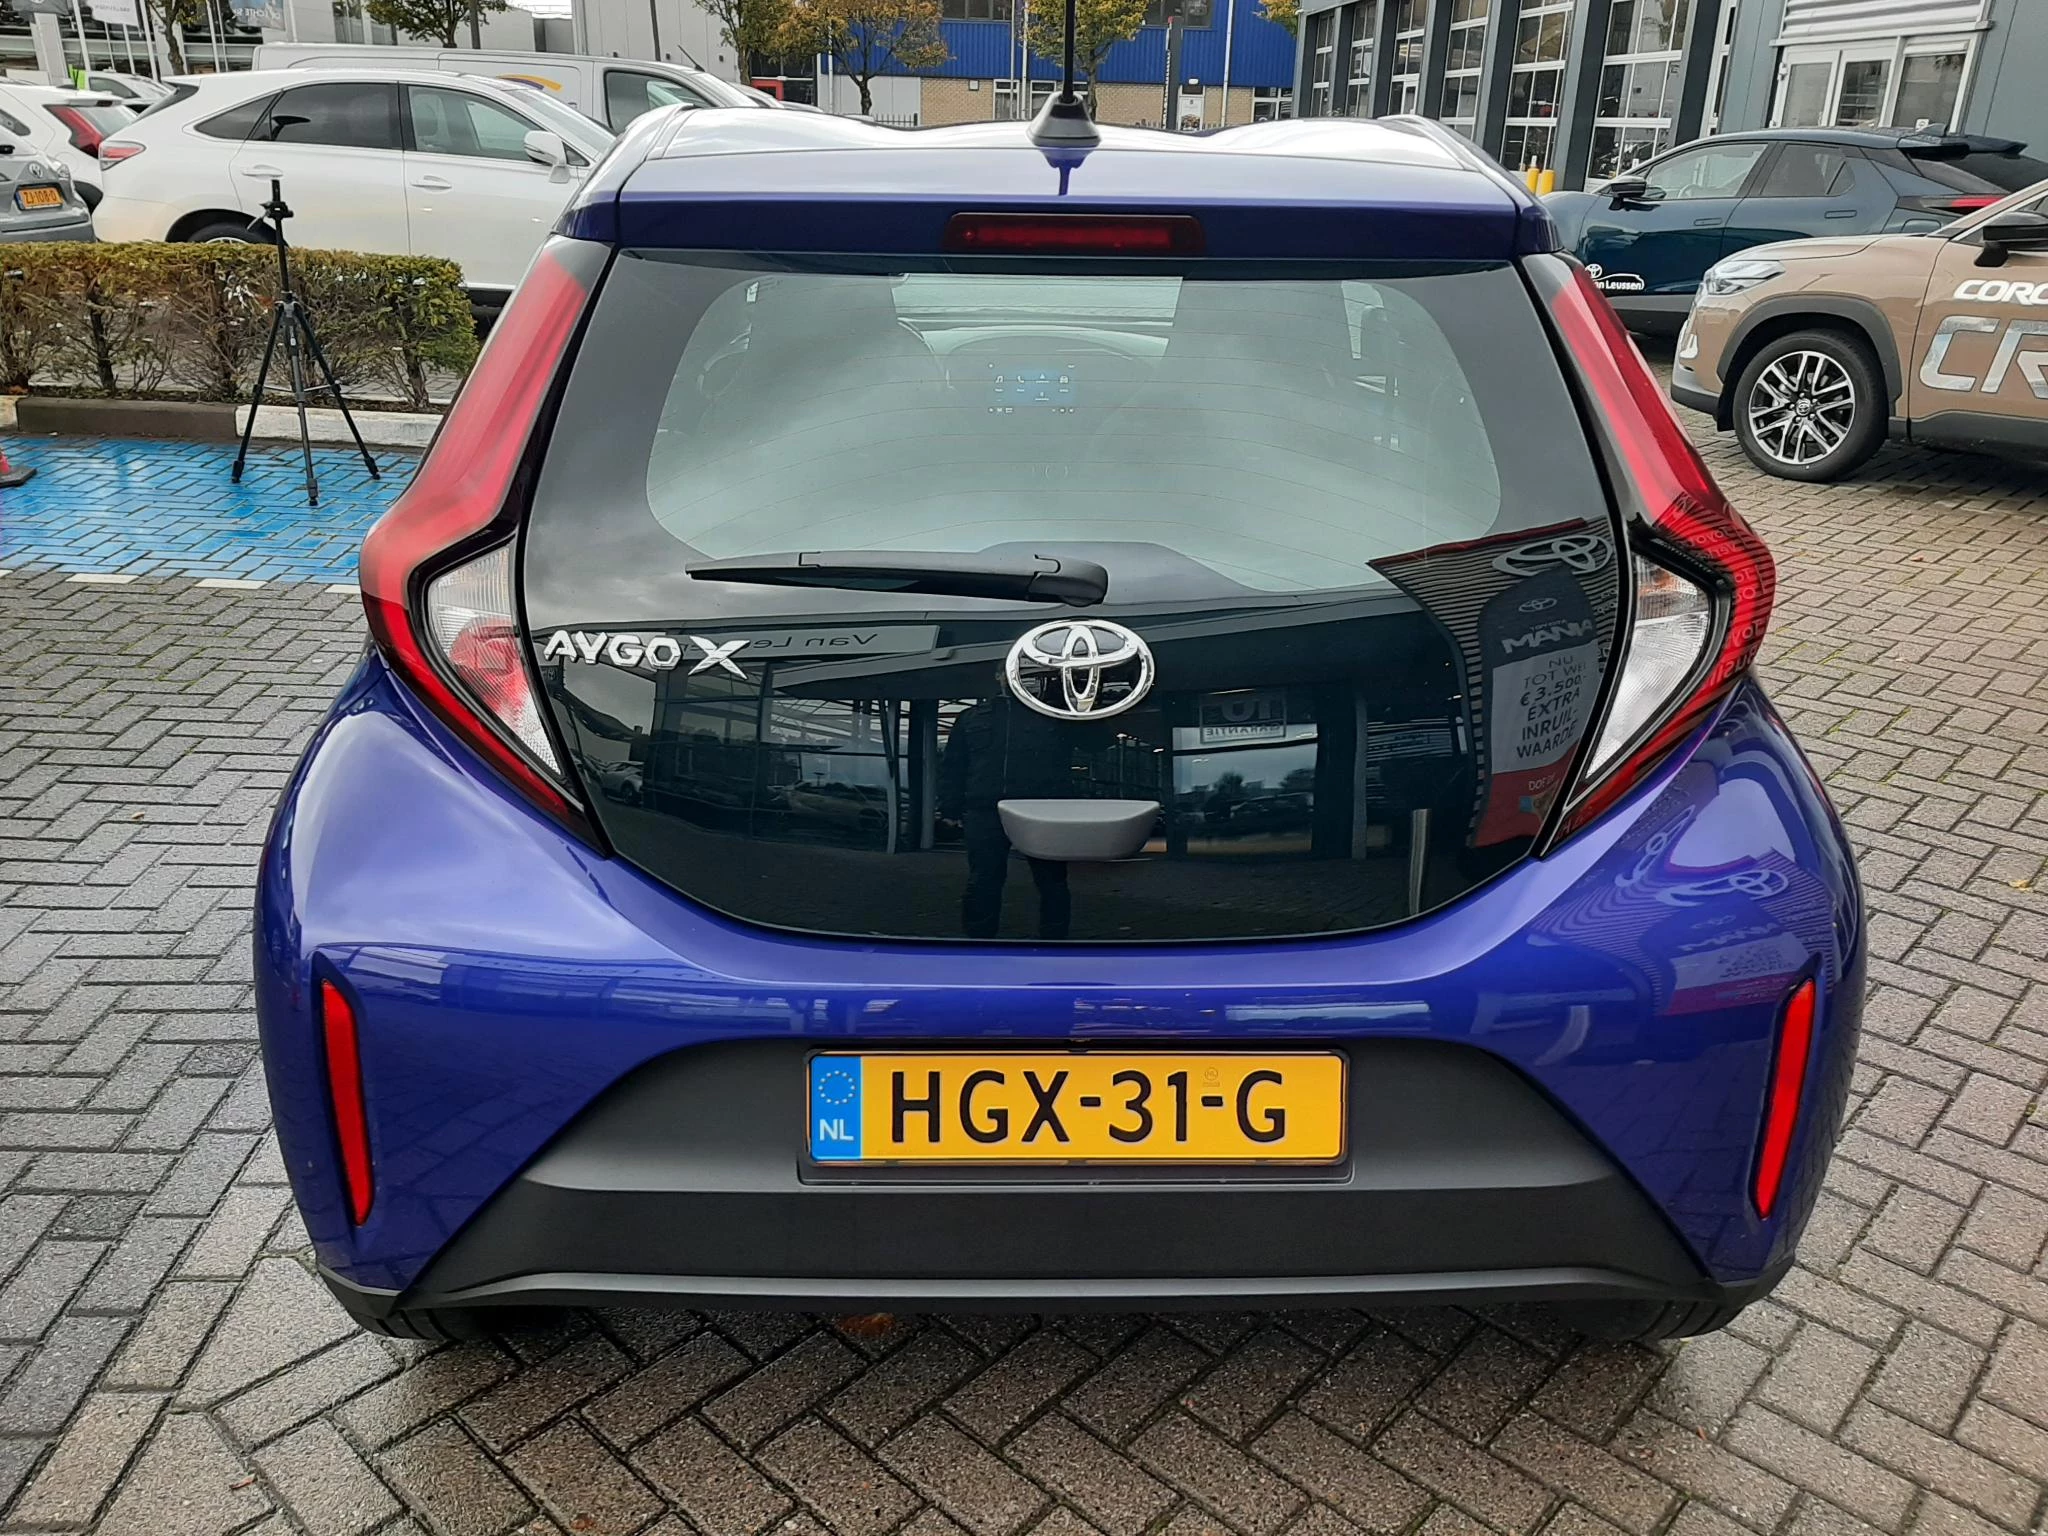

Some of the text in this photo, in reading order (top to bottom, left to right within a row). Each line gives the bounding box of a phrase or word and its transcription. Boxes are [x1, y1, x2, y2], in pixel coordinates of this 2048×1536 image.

[1606, 280, 1642, 290] Leussen
[543, 629, 751, 681] AYGO X
[1549, 655, 1573, 669] NU
[1524, 669, 1559, 689] TOT
[1527, 688, 1580, 721] EXTRA
[1516, 719, 1578, 759] WAARDE
[891, 1070, 1286, 1144] HGX-31-G
[819, 1118, 854, 1142] NL
